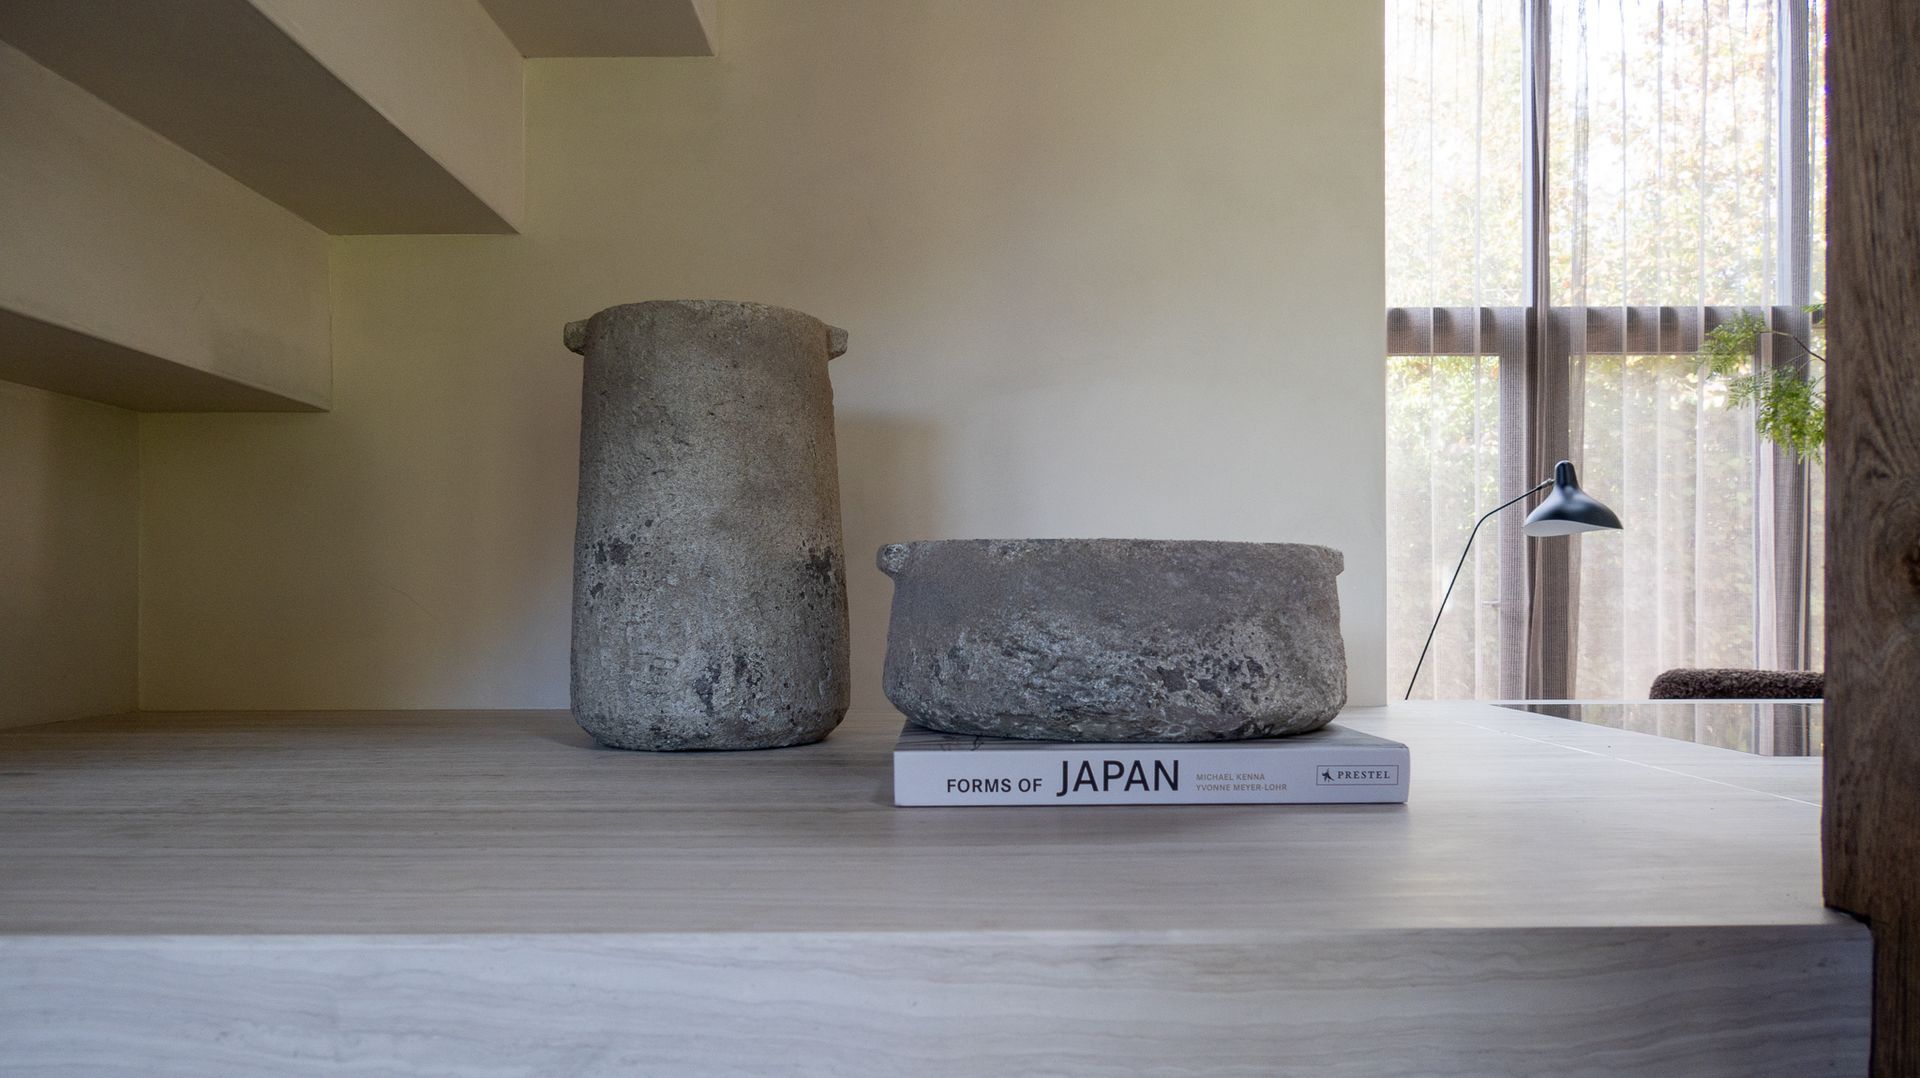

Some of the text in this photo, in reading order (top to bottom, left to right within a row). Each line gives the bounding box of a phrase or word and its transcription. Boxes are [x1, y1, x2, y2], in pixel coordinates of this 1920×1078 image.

[947, 759, 1179, 797] FORMS OF JAPAN
[1196, 773, 1265, 781] MICHAEL KENNA
[1337, 770, 1391, 780] PRESTEL
[1196, 783, 1288, 792] YVONNE MEYER-LOHR
